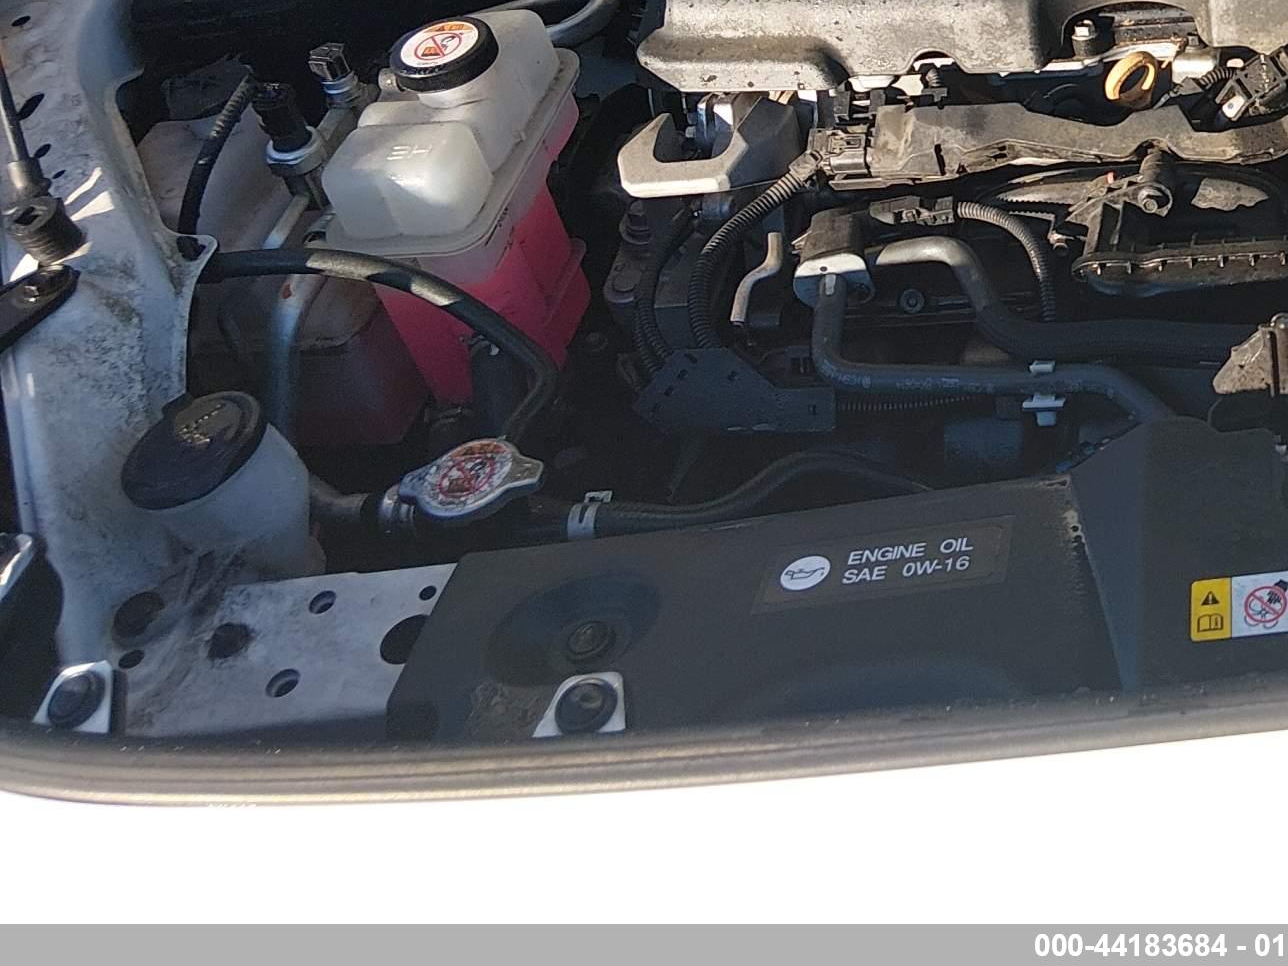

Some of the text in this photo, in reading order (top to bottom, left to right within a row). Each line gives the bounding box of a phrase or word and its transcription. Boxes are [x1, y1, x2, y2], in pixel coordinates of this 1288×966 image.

[847, 537, 974, 565] ENGINE OIL
[842, 556, 970, 584] SAE 0W-16
